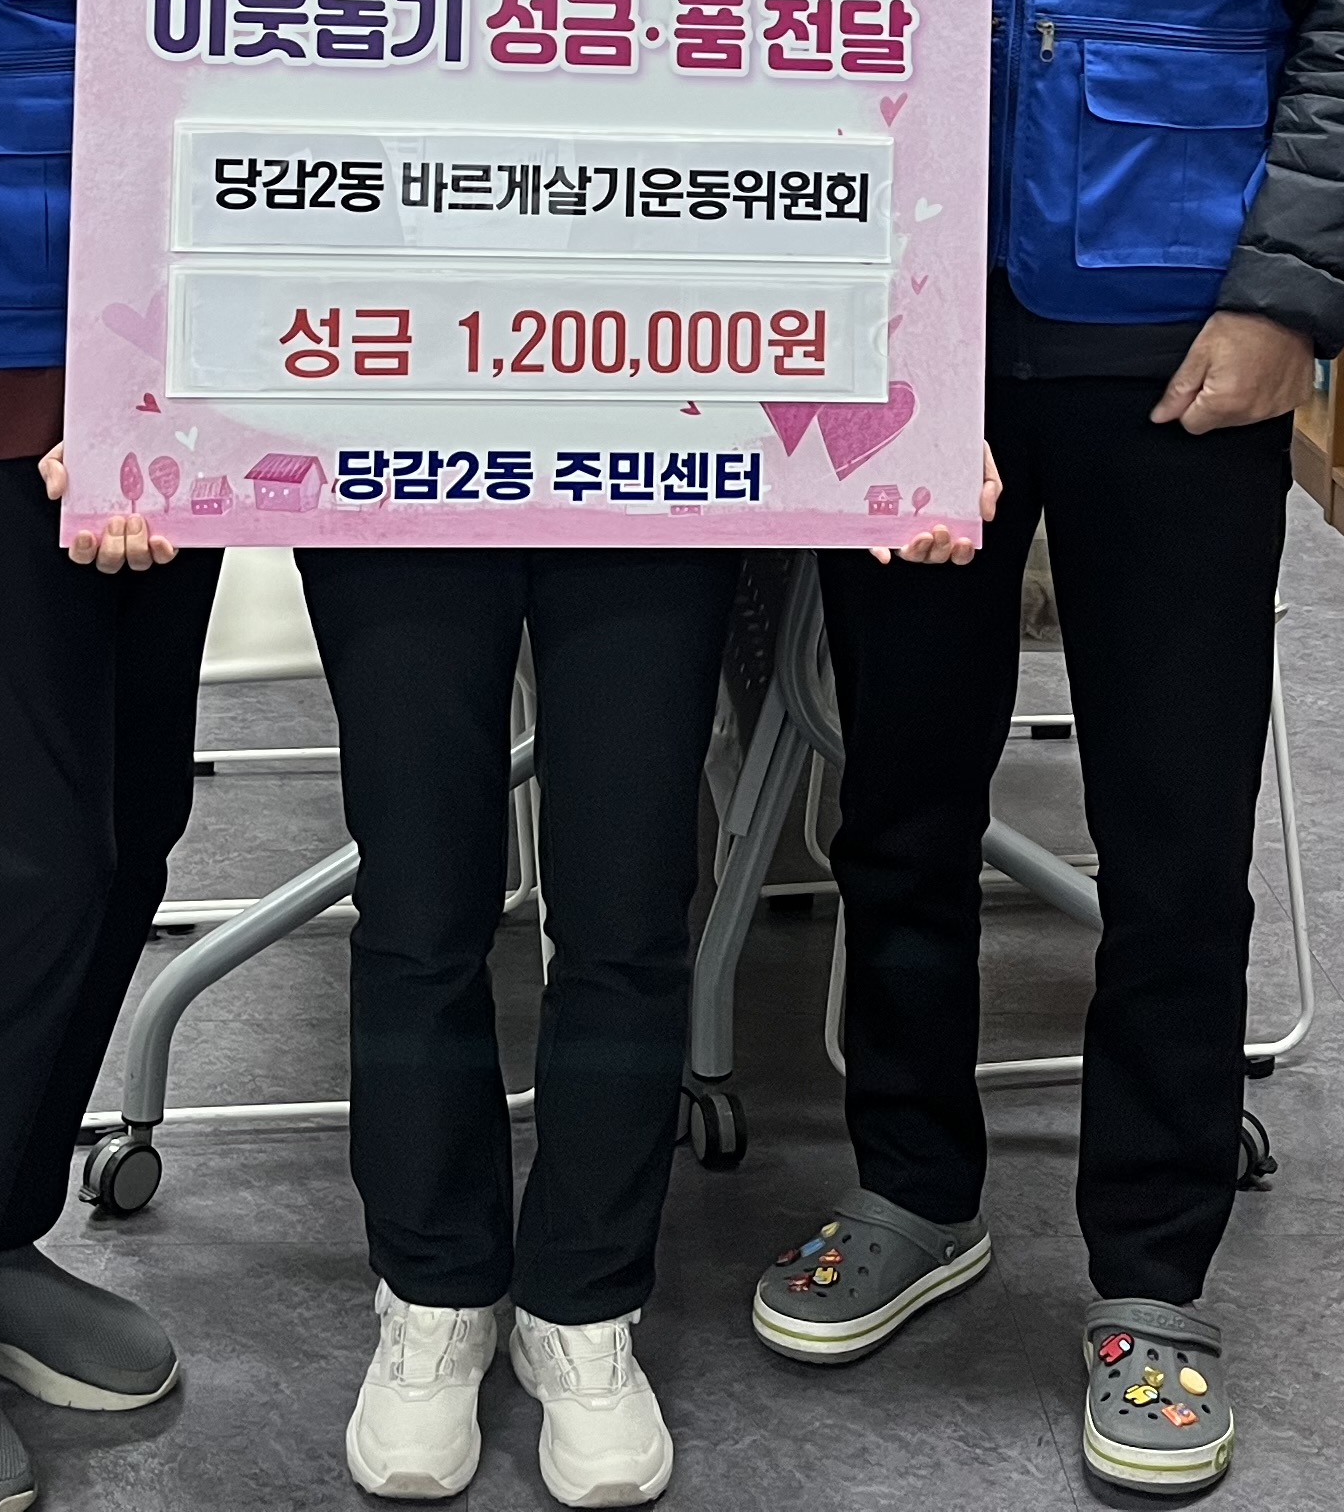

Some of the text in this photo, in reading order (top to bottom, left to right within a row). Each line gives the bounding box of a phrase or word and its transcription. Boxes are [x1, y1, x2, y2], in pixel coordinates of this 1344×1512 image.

[213, 157, 870, 223] 당감2동 바르게살기운동위원회
[279, 306, 828, 378] 성금 1,200,000원
[334, 451, 762, 504] 당감2동 주민센터
